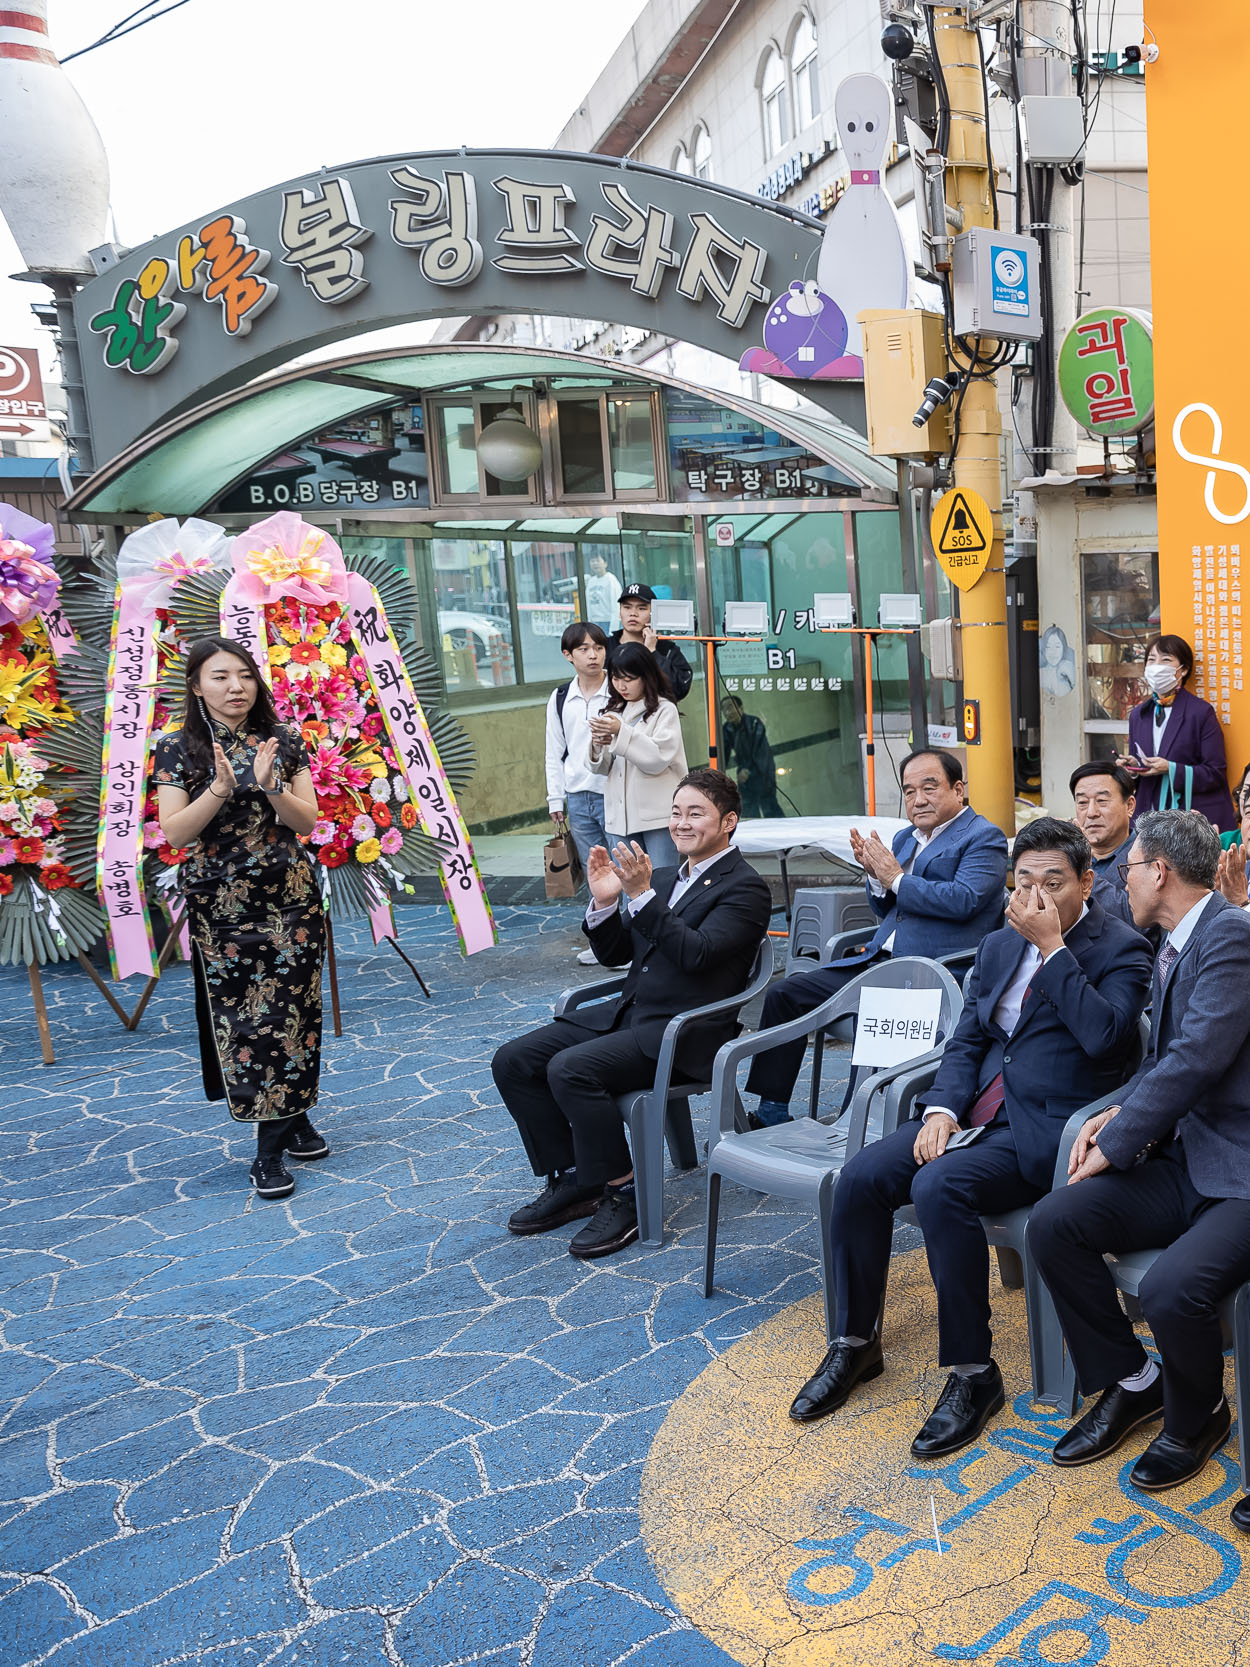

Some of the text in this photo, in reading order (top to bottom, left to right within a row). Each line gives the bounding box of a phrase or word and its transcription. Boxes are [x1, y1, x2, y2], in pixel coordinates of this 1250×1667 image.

[89, 164, 773, 376] 한아름 볼링프라자
[1077, 316, 1136, 425] 과일
[250, 480, 418, 504] B.O.B 당구장 B1
[688, 468, 801, 492] 탁구장 B1
[952, 535, 973, 547] SOS
[948, 555, 979, 567] 긴급신고
[42, 609, 72, 639] 祝
[353, 605, 389, 647] 祝
[768, 648, 797, 669] B1
[373, 659, 473, 891] 화양제일시장
[106, 760, 141, 838] 상인회장
[863, 1017, 935, 1041] 국회의원님
